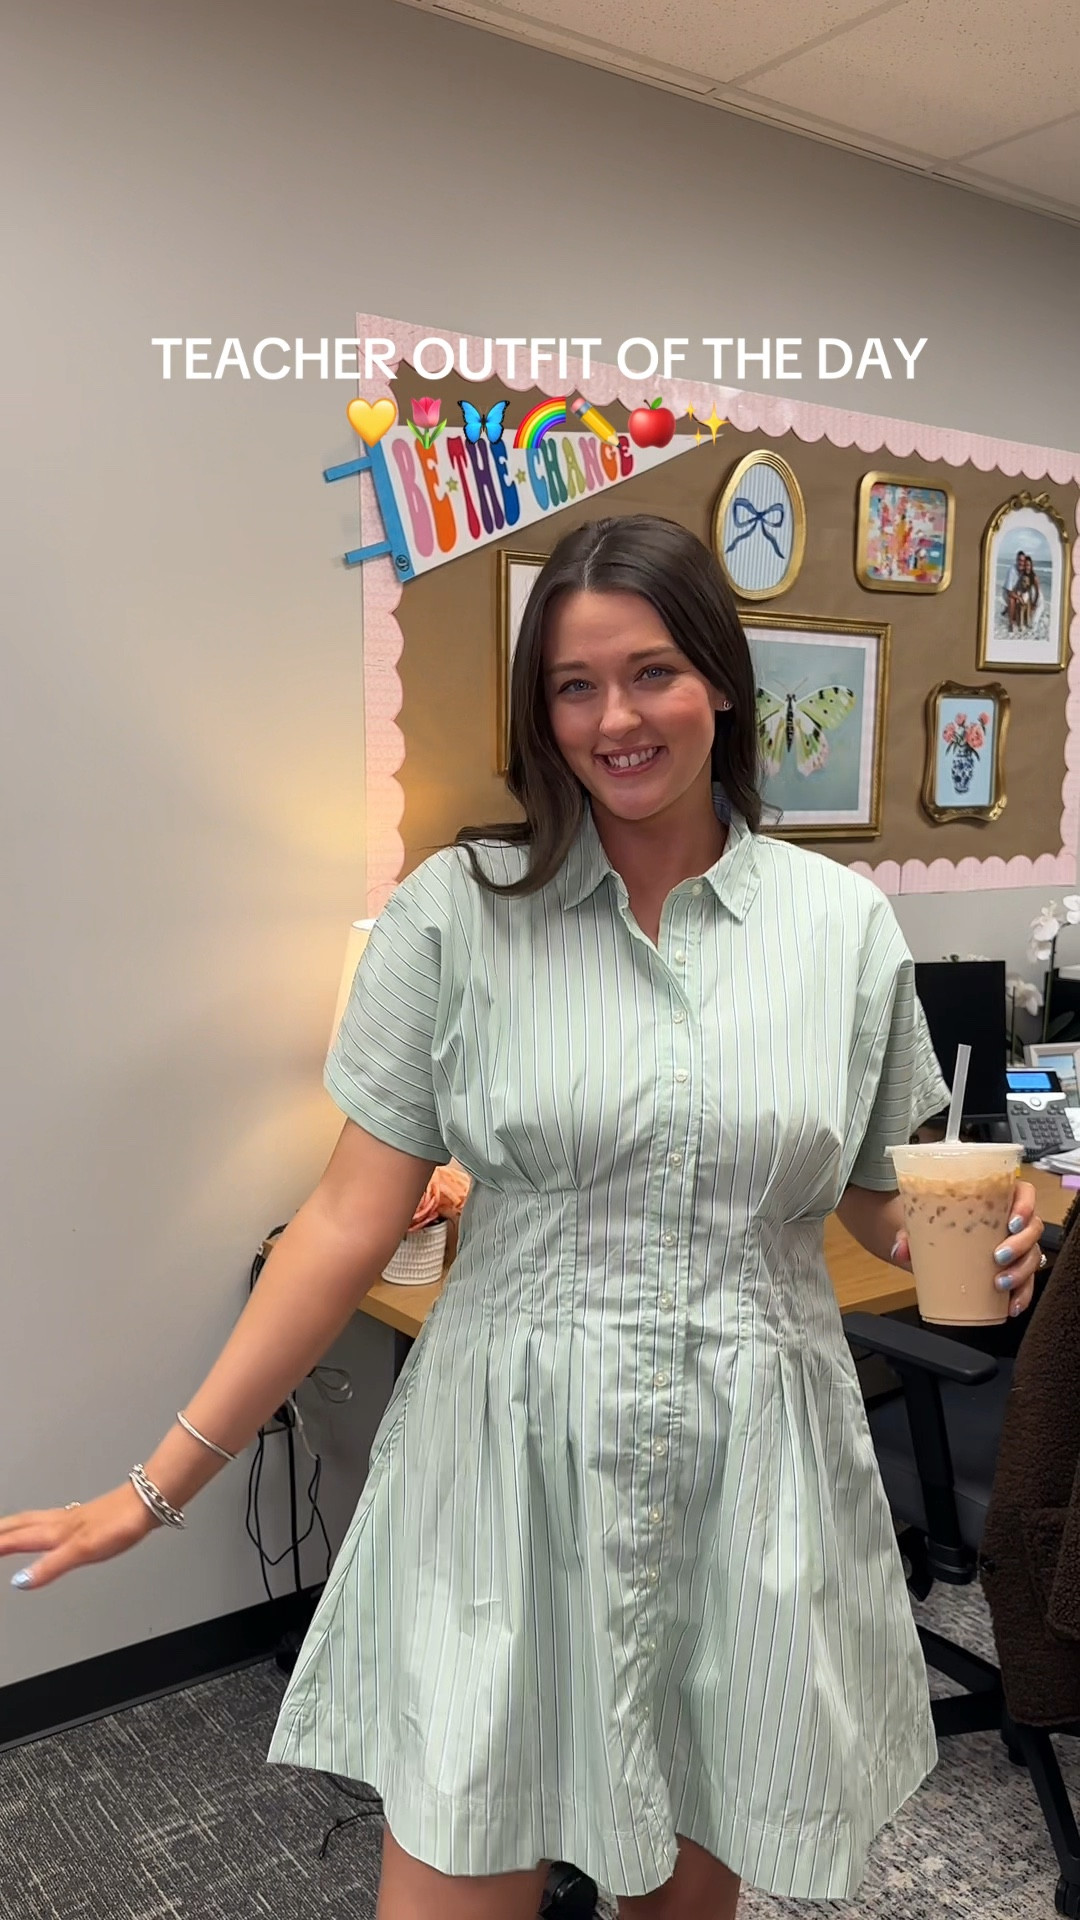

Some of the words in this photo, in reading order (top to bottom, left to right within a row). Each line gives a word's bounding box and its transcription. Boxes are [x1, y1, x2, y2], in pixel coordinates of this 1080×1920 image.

[391, 437, 457, 558] BE
[446, 435, 520, 540] THE
[525, 435, 634, 512] CHANGE
